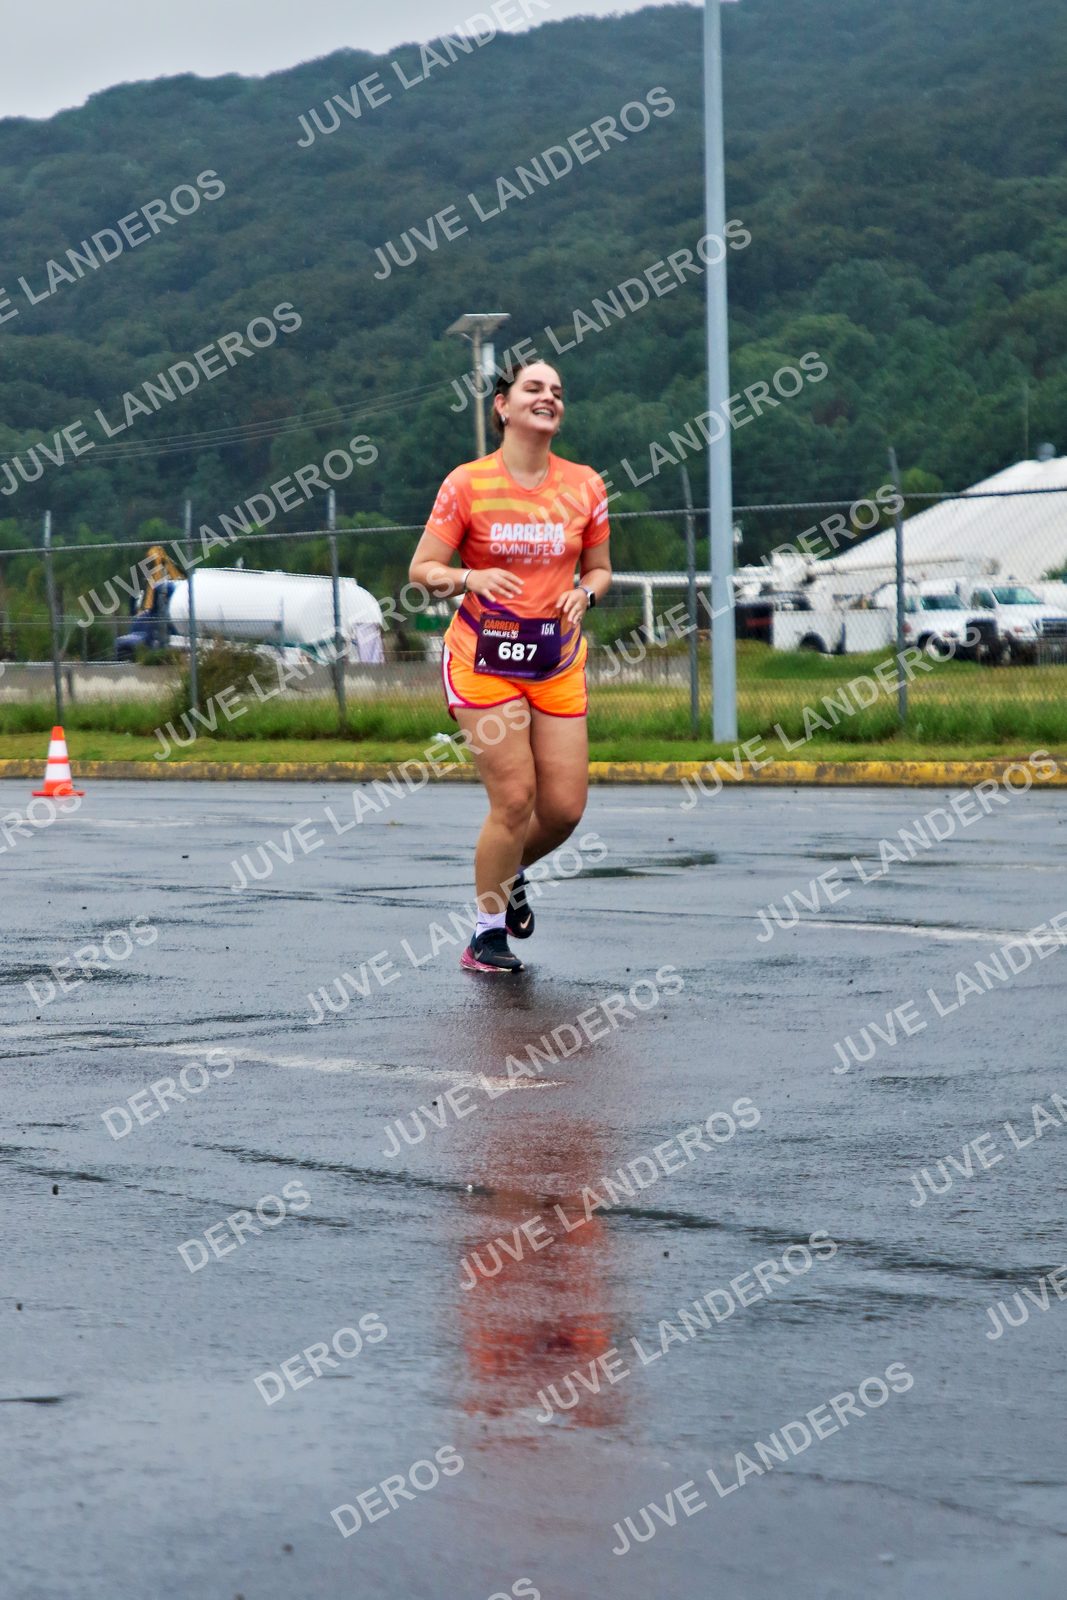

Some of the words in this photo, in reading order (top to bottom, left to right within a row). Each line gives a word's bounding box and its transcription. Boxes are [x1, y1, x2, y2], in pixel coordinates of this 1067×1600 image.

[490, 522, 565, 543] CARRERA
[485, 619, 520, 631] CARRERA
[498, 641, 538, 662] 687
